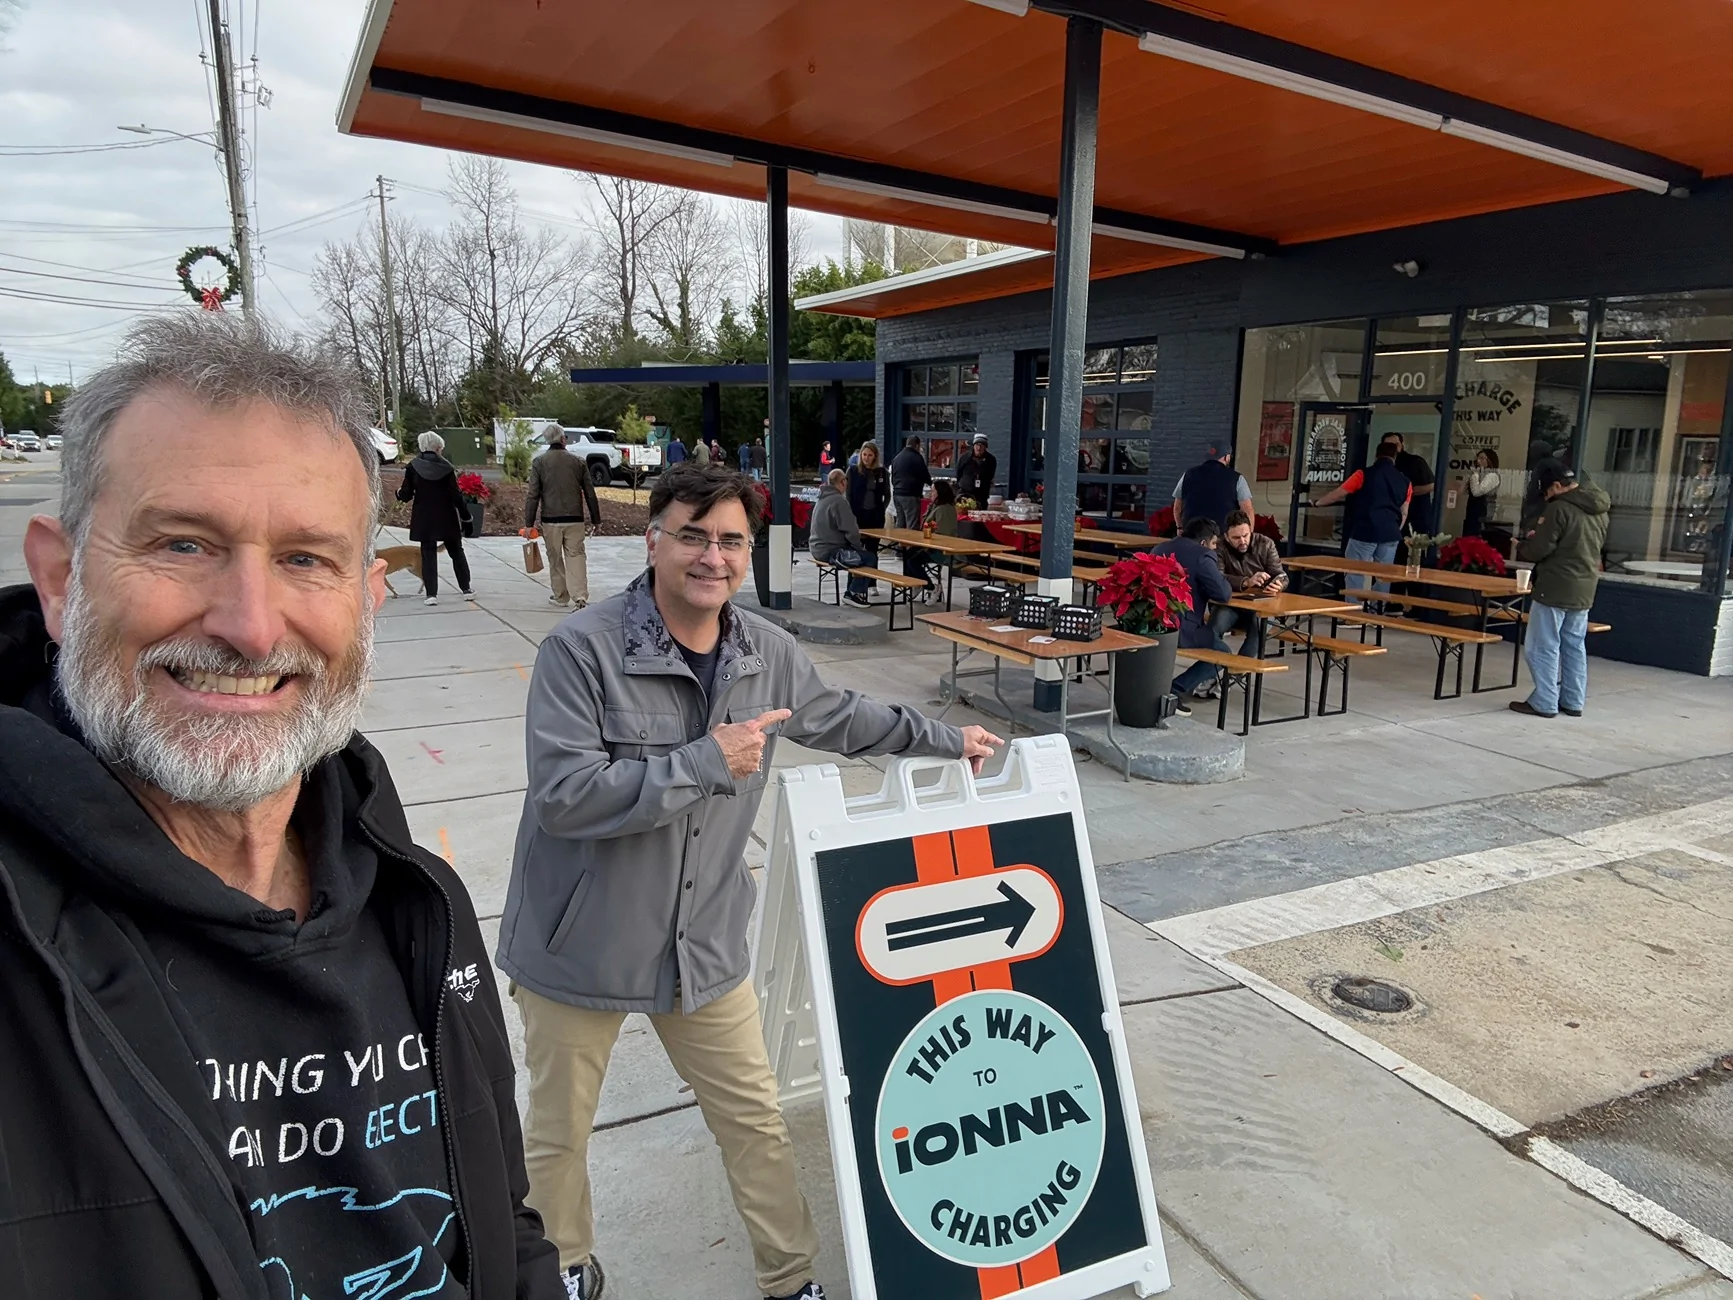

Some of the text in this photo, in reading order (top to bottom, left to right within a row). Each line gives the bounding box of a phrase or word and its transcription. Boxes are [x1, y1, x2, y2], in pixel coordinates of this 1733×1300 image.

[1387, 371, 1426, 390] 400
[1452, 410, 1503, 421] HIS WAY
[905, 1006, 1058, 1086] THIS WAY
[973, 1067, 997, 1087] TO
[278, 1117, 345, 1163] DO
[929, 1158, 1082, 1249] CHARGING
